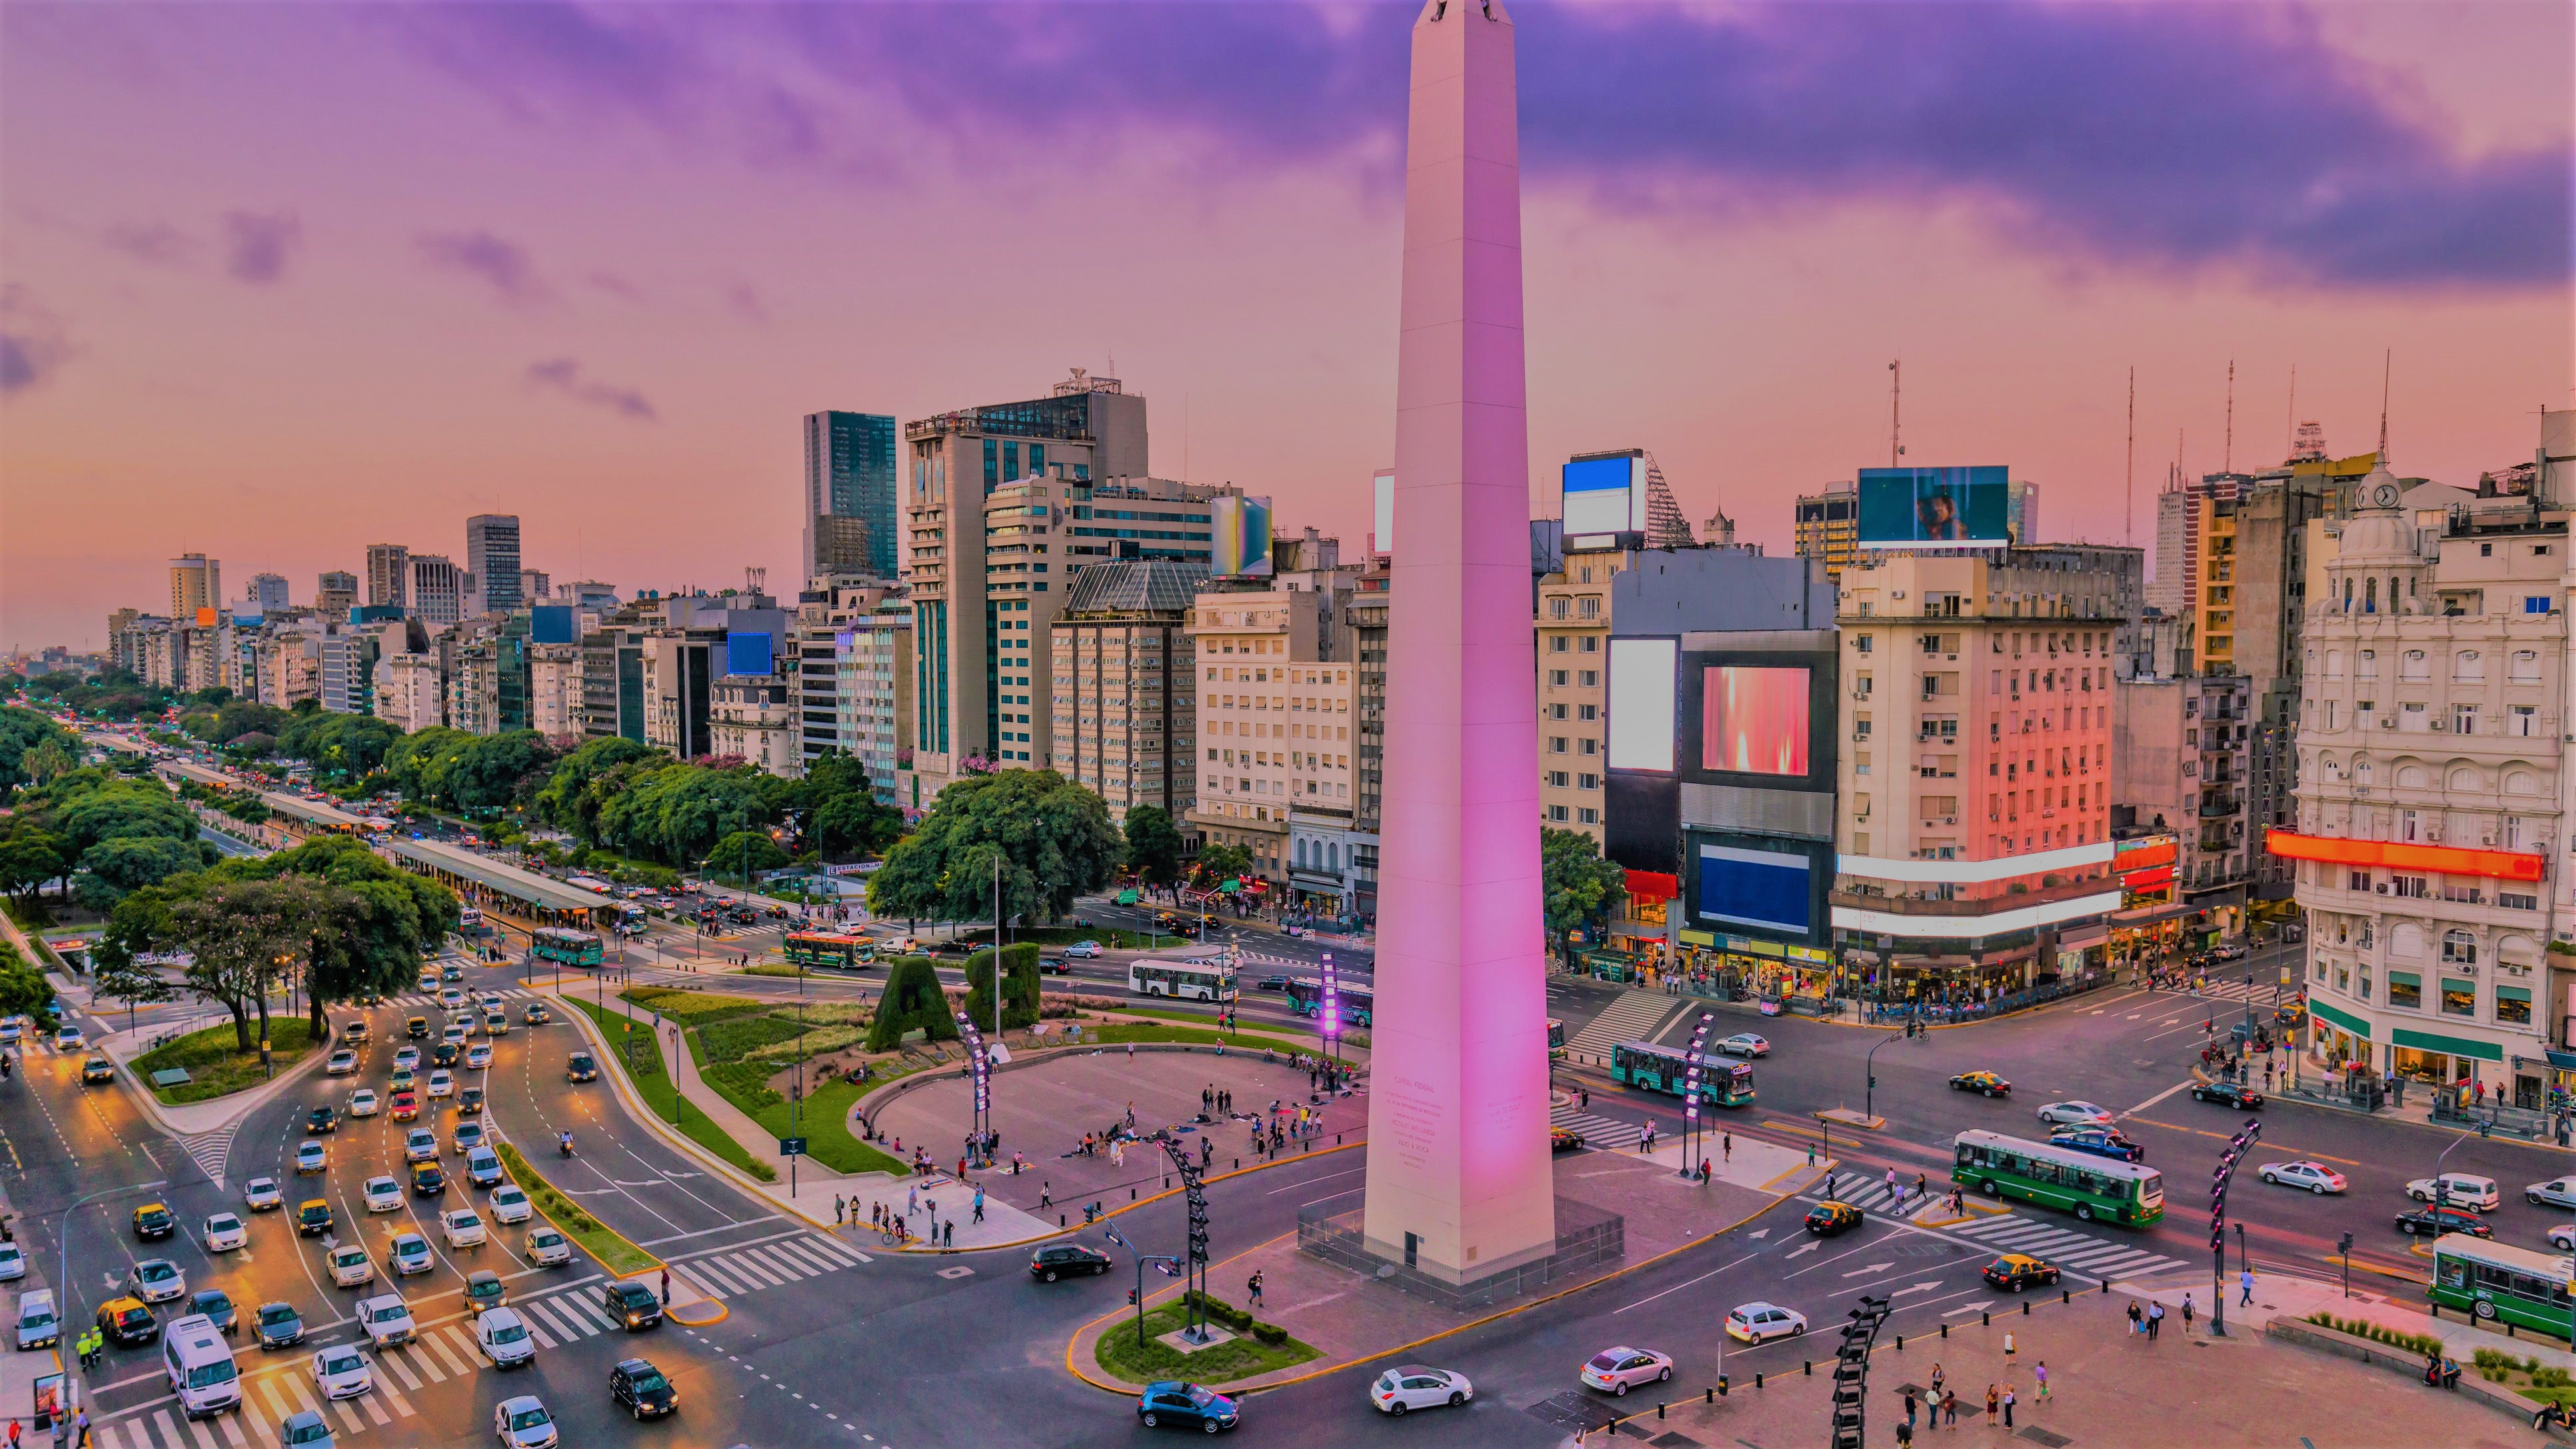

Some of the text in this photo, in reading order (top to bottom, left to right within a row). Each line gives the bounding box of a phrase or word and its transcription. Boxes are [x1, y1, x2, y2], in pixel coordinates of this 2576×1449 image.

[1346, 1010, 1354, 1018] 10
[1394, 1076, 1435, 1093] CAPITAL FEDERAL
[1397, 1139, 1410, 1148] JULIO
[1416, 1144, 1429, 1153] ROCA
